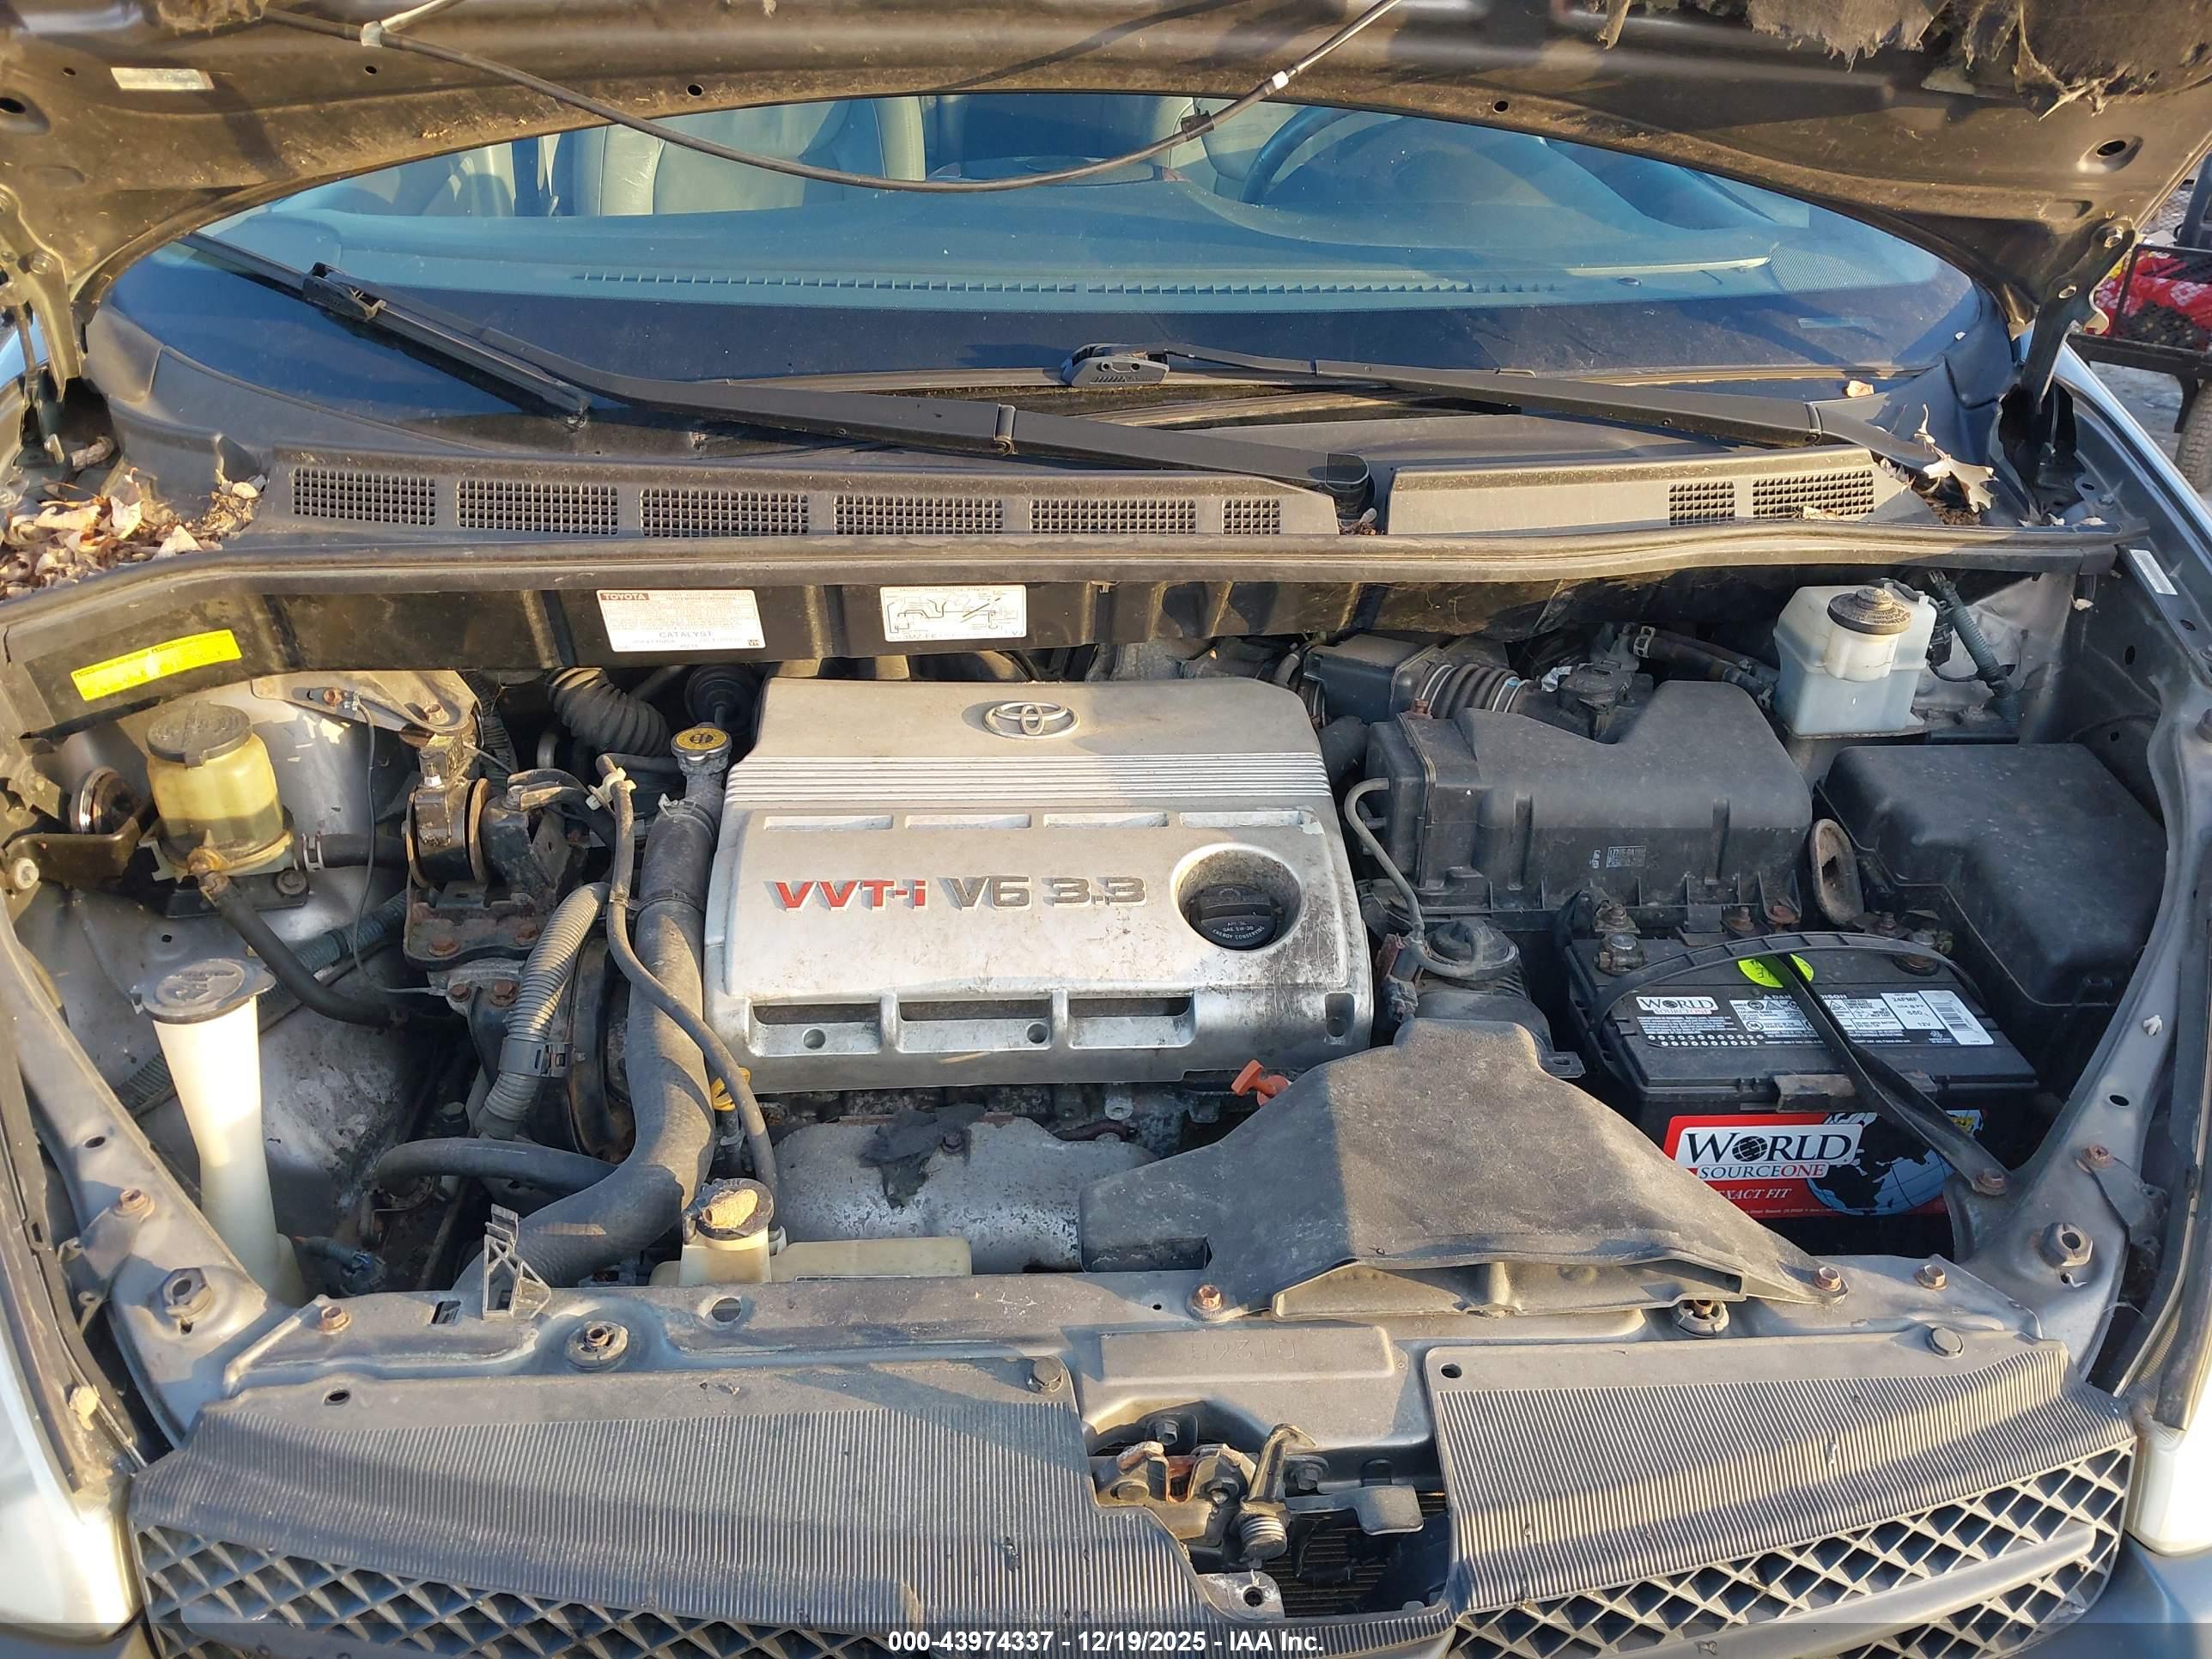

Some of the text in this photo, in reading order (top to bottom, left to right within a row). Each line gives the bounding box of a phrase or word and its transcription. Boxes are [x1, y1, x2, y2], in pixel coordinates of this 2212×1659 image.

[775, 876, 1148, 912] VVT-i V6 3.3
[1639, 999, 1714, 1009] WORLD
[1685, 1132, 1853, 1164] WORLD
[1698, 1164, 1826, 1180] SOURCEONE
[1765, 1188, 1792, 1199] FIT
